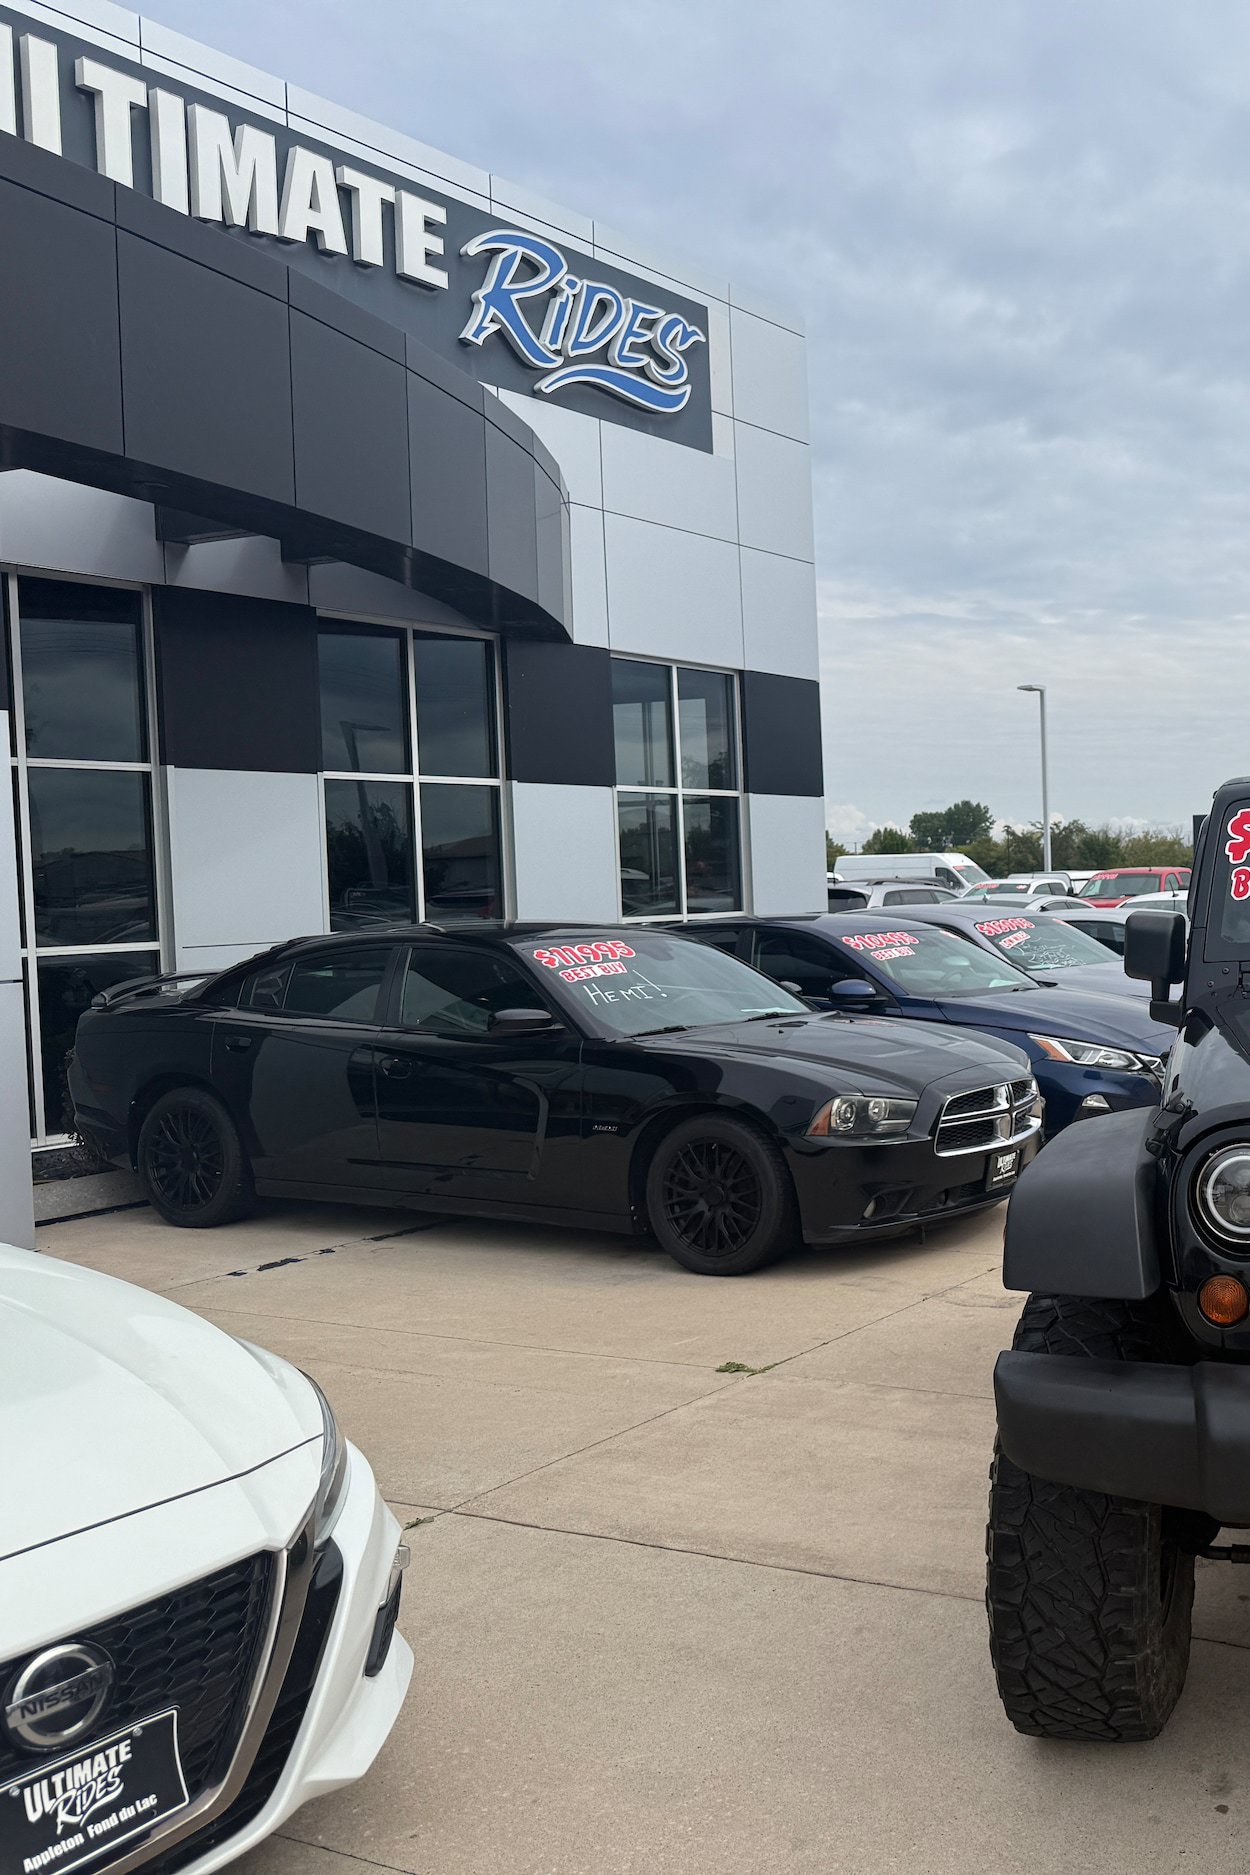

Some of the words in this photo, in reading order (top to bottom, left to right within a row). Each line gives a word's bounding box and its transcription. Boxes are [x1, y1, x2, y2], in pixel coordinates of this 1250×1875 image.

[0, 21, 449, 290] TIMATE
[534, 941, 635, 967] $11995
[842, 931, 919, 950] $10495
[560, 964, 597, 982] BEST
[599, 962, 627, 975] BUY
[20, 1674, 99, 1719] NISSAN
[23, 1739, 132, 1824] ULTIMATE
[23, 1832, 84, 1873] Appleton
[87, 1811, 120, 1839] Fond
[119, 1803, 136, 1822] du
[136, 1793, 158, 1813] Lac
